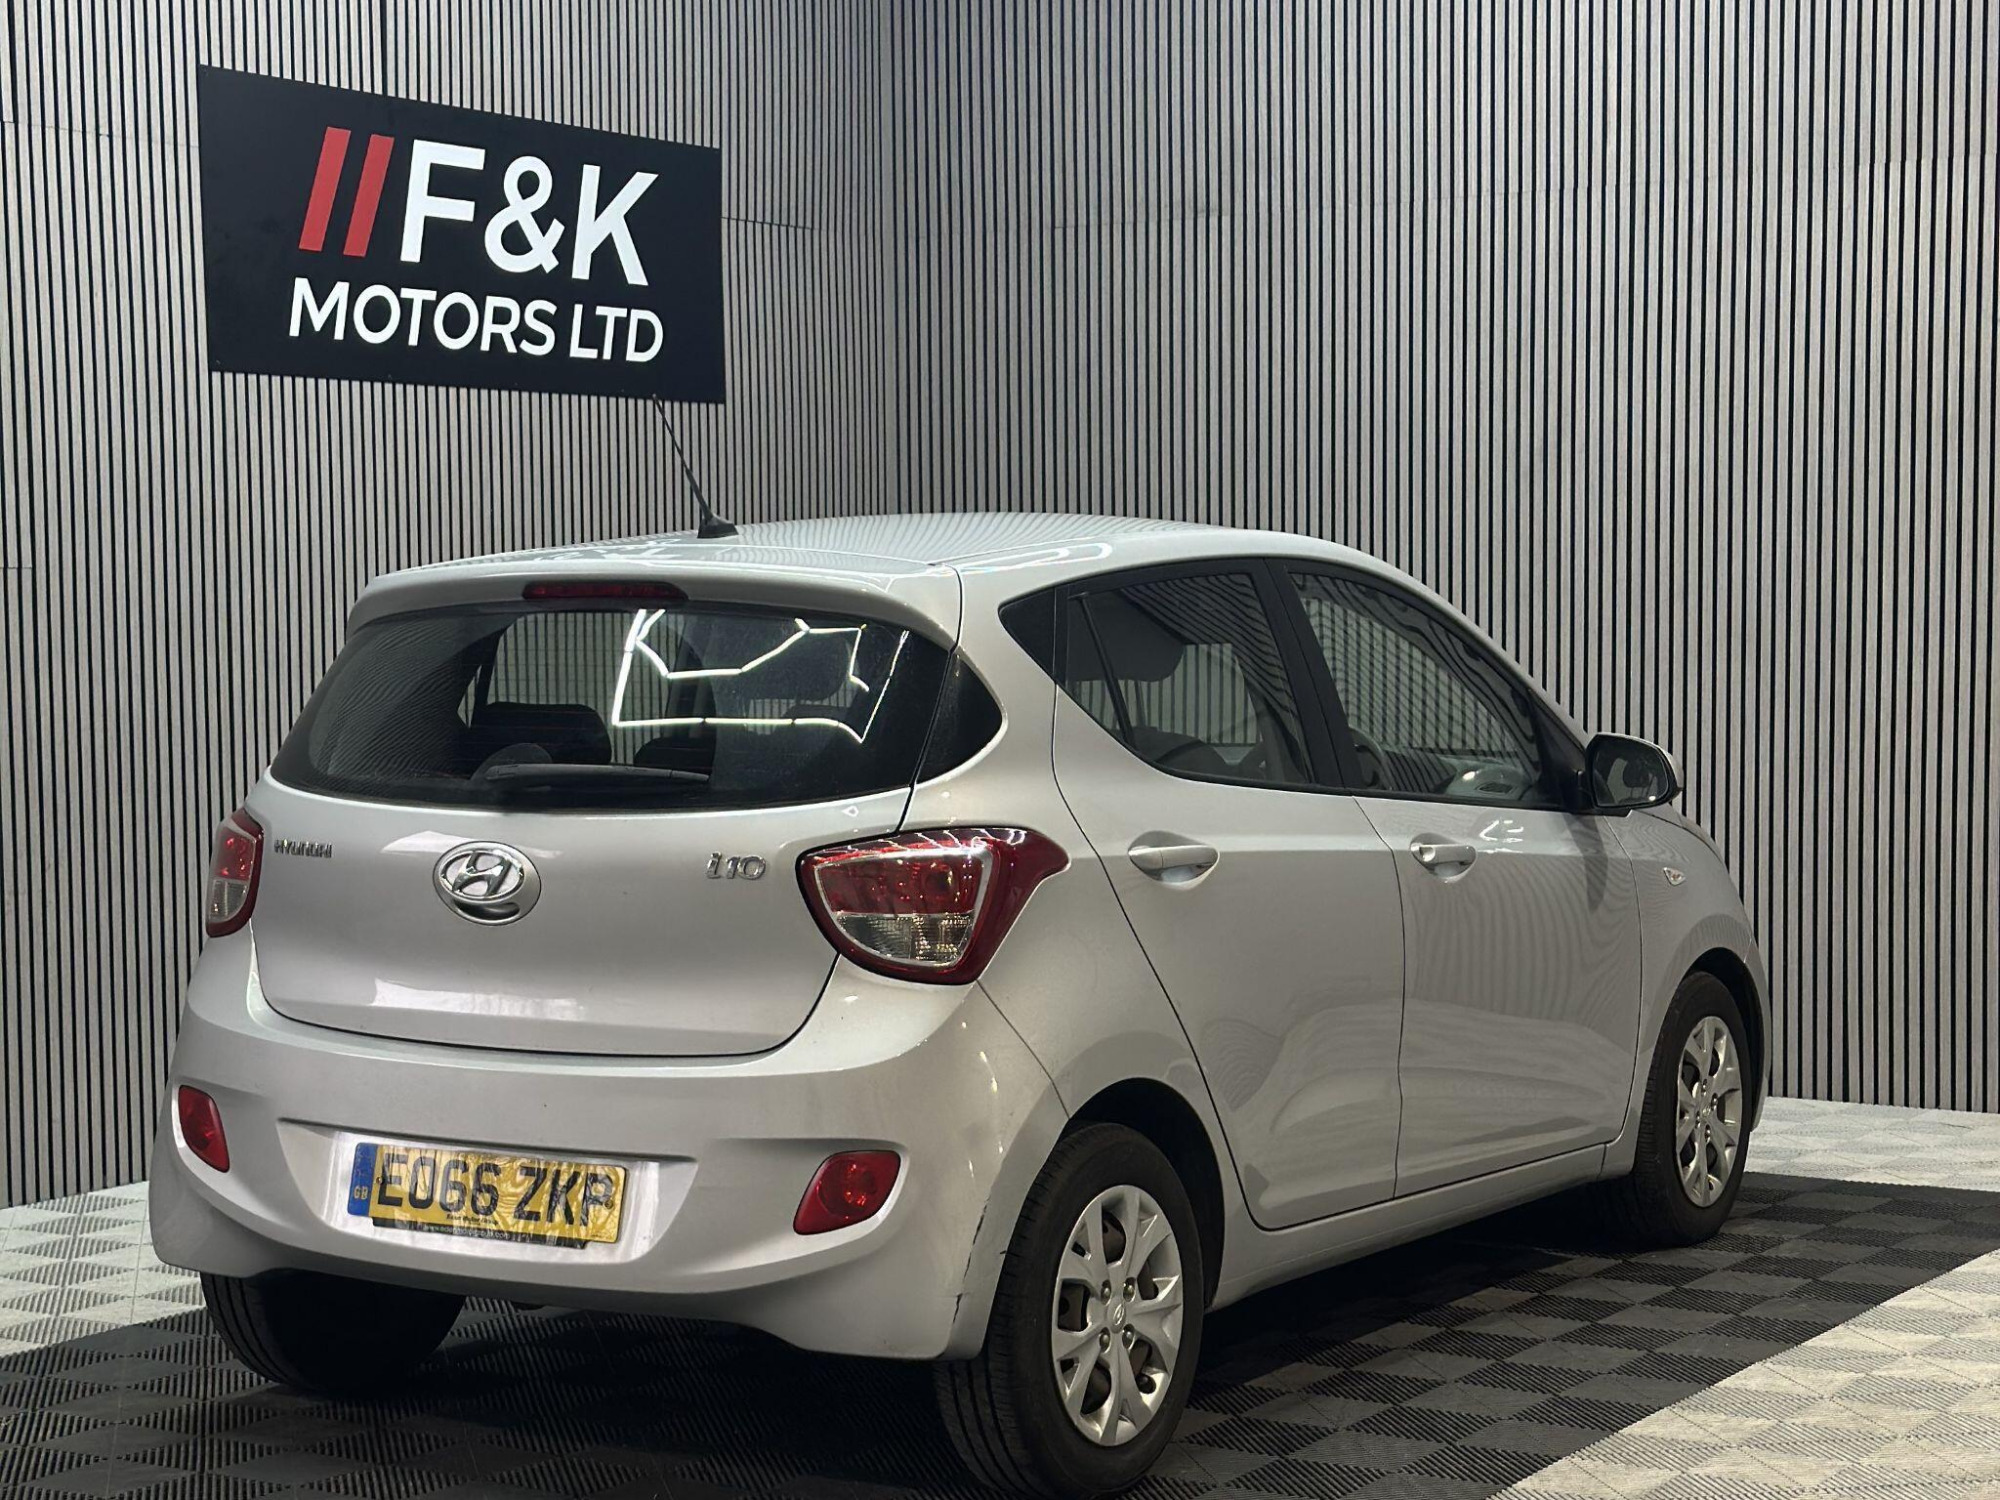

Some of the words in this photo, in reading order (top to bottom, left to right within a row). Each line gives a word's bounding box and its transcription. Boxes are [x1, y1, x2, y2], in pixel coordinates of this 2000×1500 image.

[288, 276, 557, 357] MOTORS
[569, 303, 664, 363] LTD
[273, 839, 332, 858] HYUNDAI
[353, 1185, 369, 1200] GB
[513, 1165, 614, 1227] ZKP
